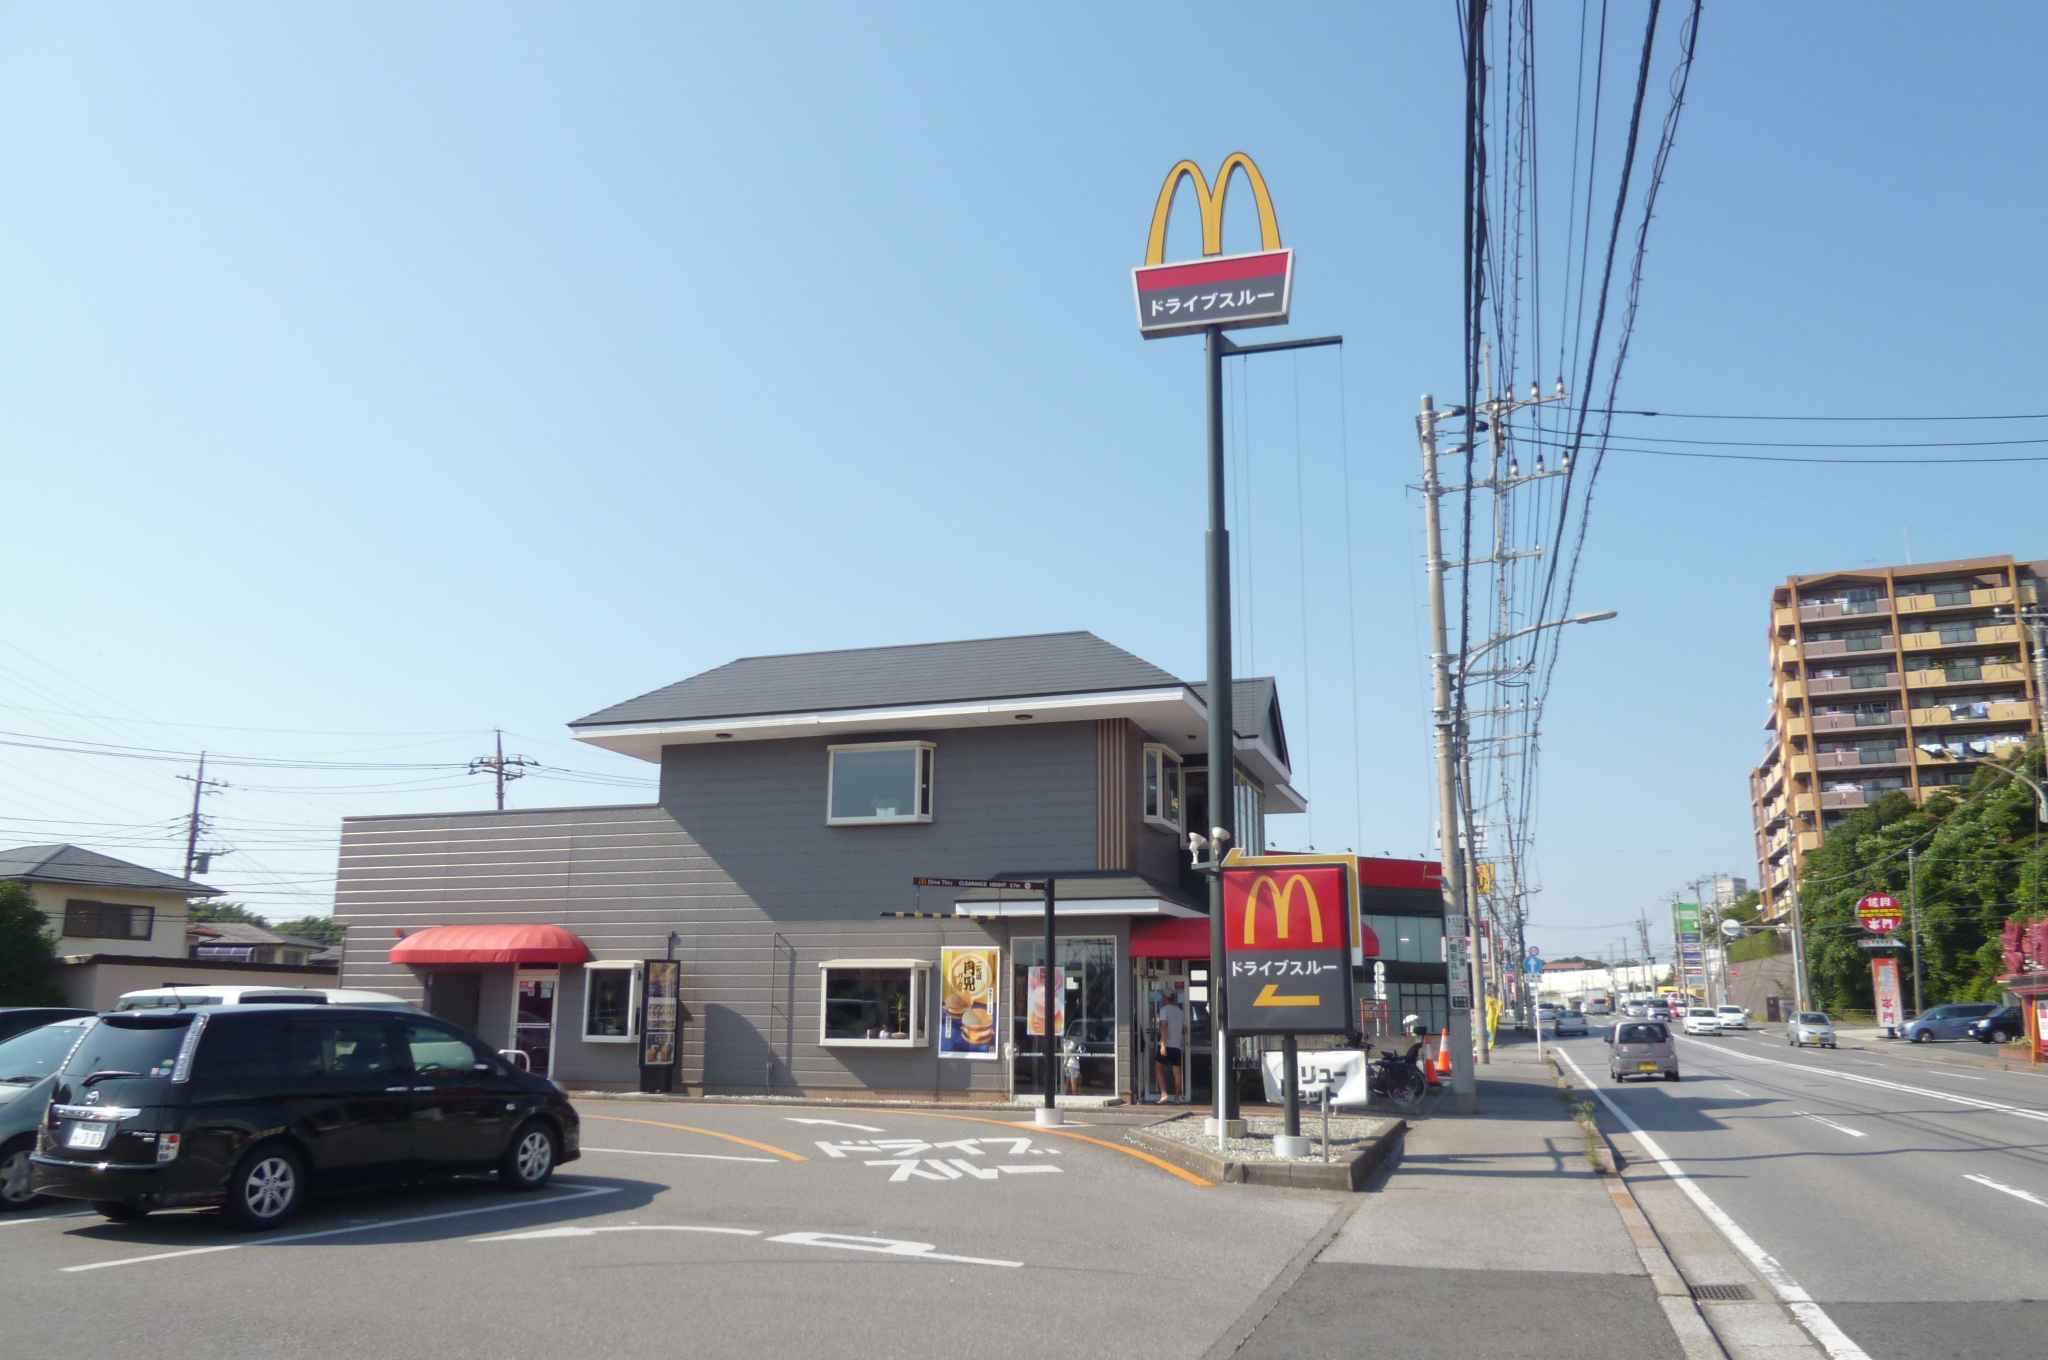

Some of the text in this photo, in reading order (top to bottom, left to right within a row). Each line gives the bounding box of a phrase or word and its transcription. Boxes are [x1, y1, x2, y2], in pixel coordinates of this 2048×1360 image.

[1151, 290, 1275, 317] ドライブスルー
[1232, 959, 1338, 977] ドライブスルー
[813, 1137, 1062, 1158] ドライブ
[863, 1158, 1065, 1182] スルー
